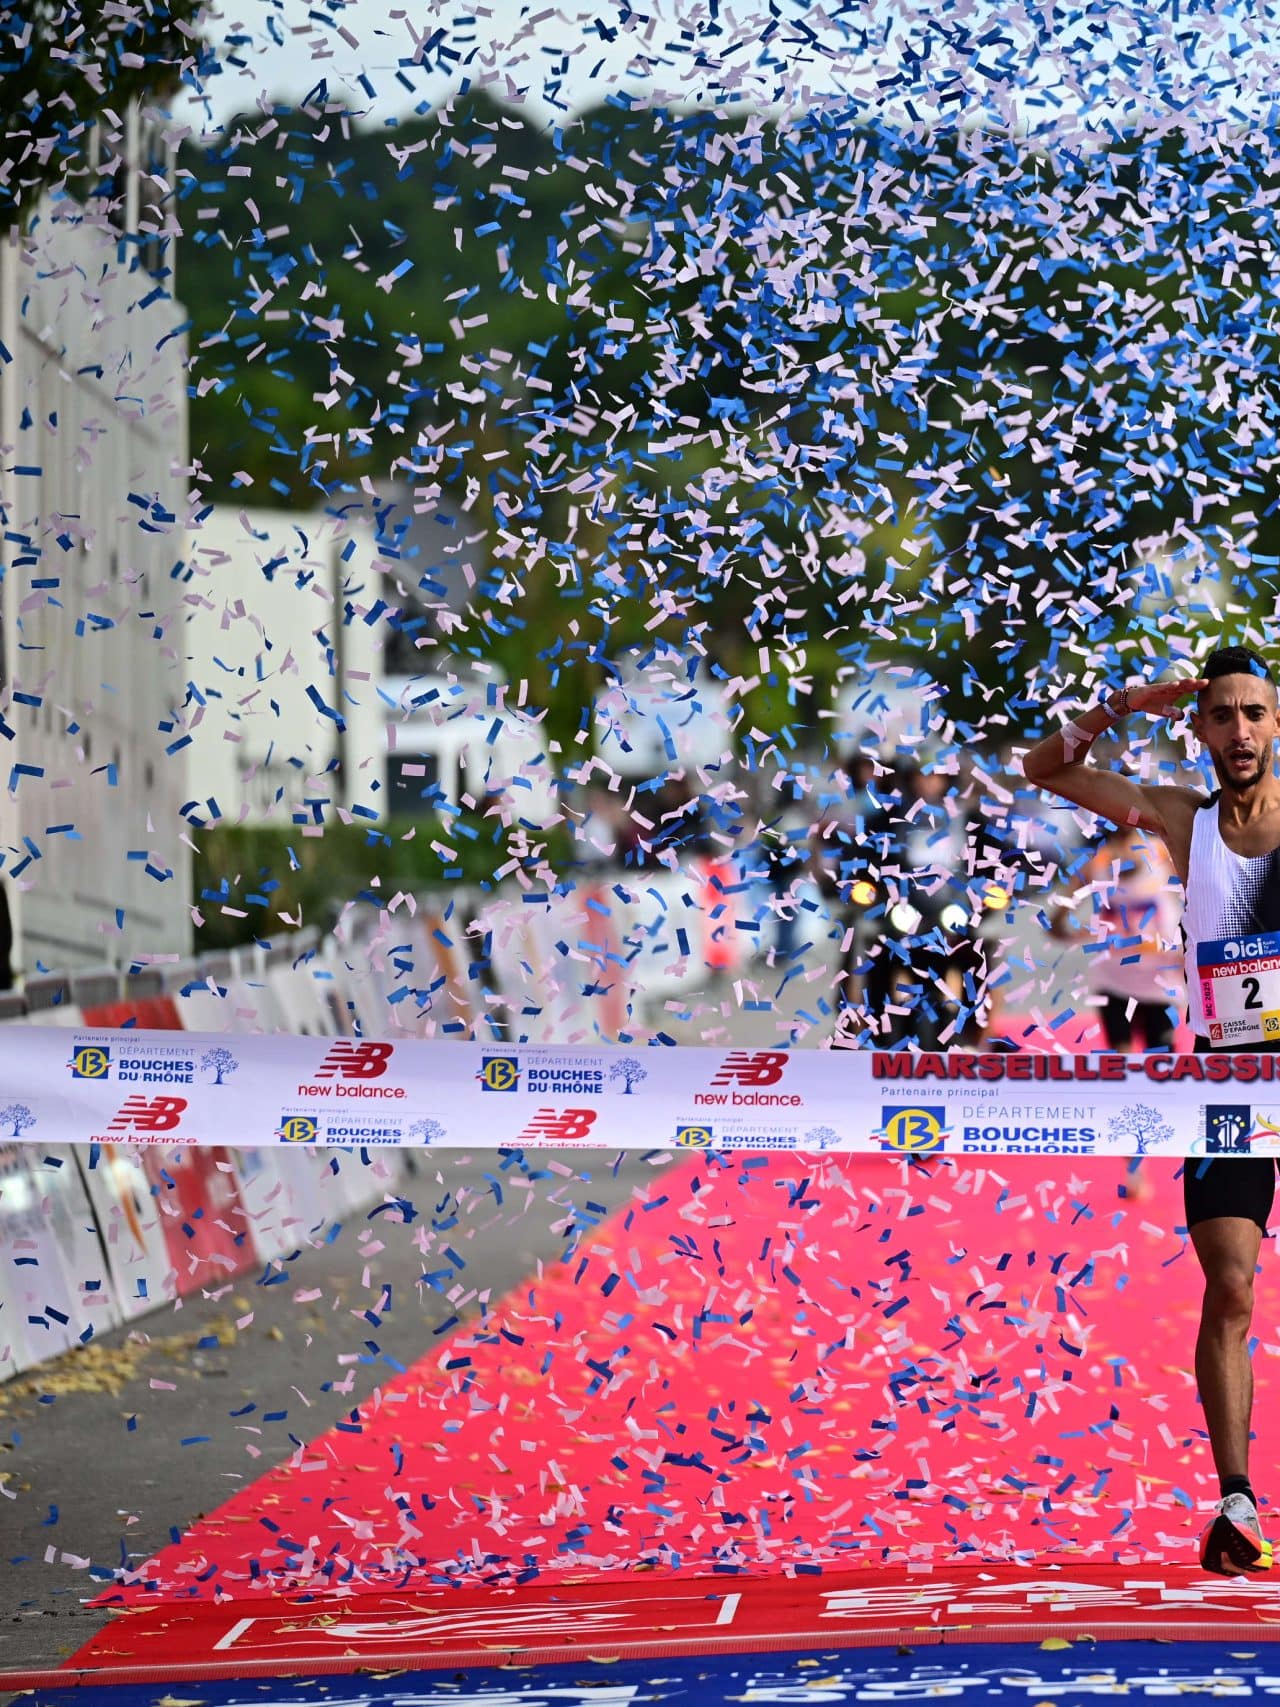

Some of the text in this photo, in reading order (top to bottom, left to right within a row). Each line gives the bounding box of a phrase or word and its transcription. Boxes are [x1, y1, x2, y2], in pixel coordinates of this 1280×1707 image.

[1212, 964, 1238, 977] new
[1241, 977, 1263, 1010] 2
[1223, 1019, 1247, 1028] CAISSE
[119, 1046, 195, 1056] DÉPARTEMENT
[527, 1057, 603, 1066] DÉPARTEMENT
[298, 1084, 405, 1098] new balance
[881, 1087, 999, 1098] Partenaire principal
[694, 1091, 801, 1106] new balance
[962, 1104, 1096, 1119] DÉPARTEMENT
[897, 1116, 934, 1148] 13
[90, 1135, 123, 1143] new
